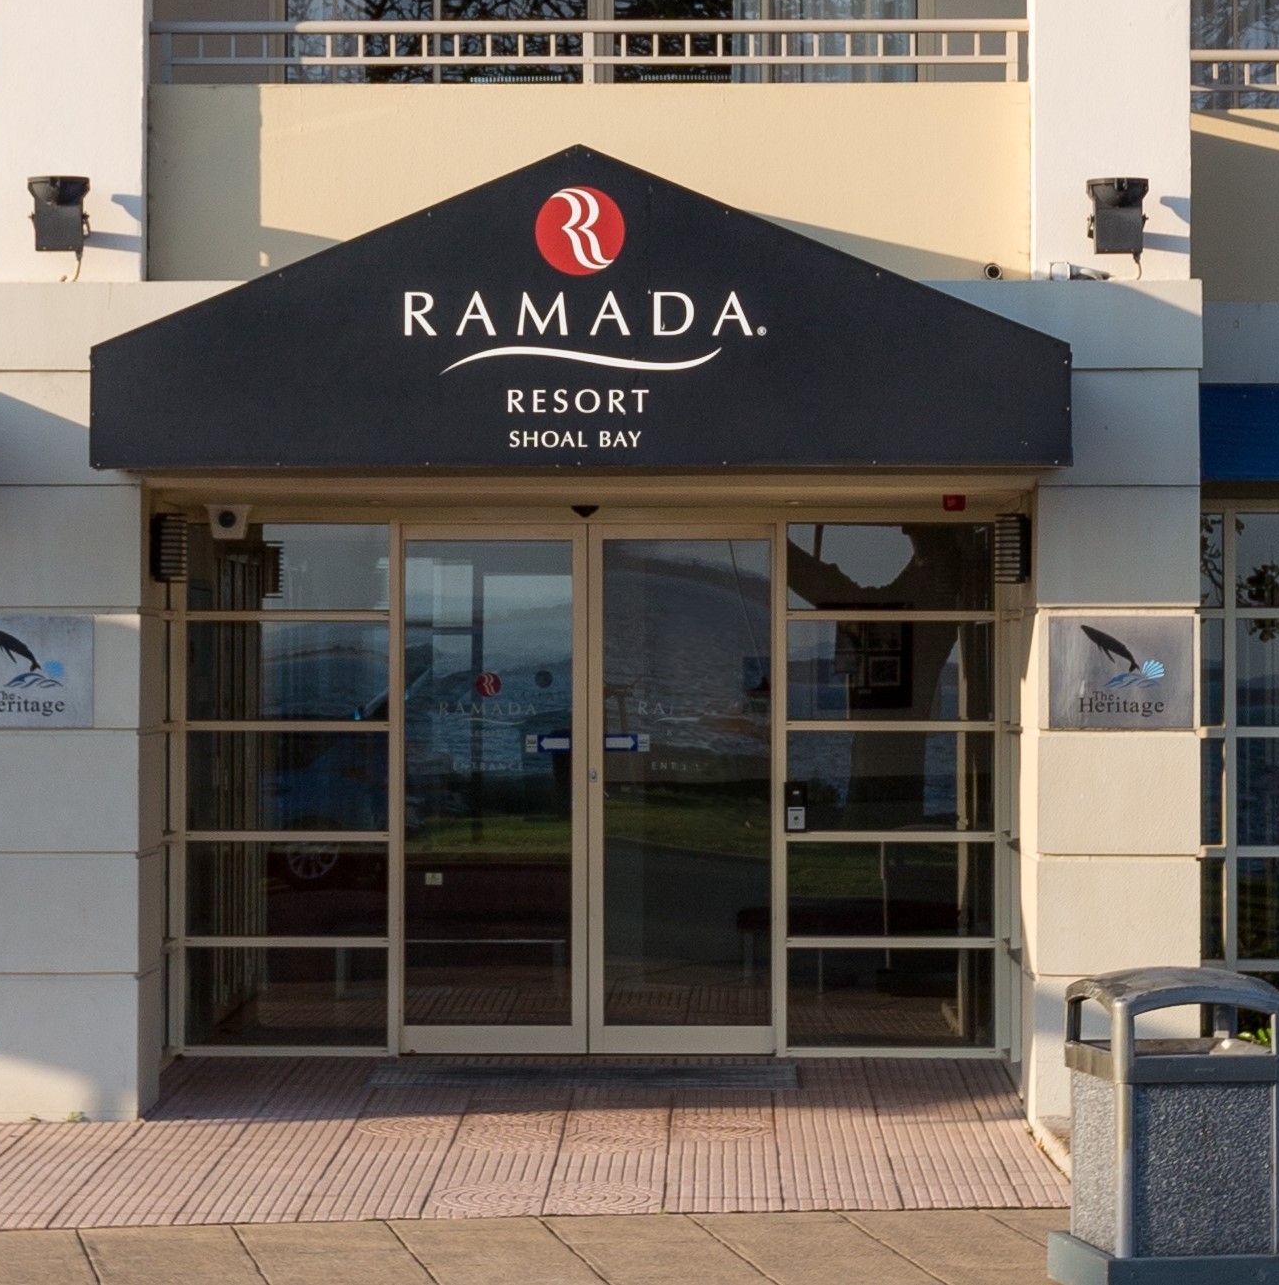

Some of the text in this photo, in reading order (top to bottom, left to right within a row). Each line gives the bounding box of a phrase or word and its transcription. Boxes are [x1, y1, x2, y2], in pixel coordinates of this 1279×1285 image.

[507, 389, 650, 416] RESORT
[509, 431, 642, 449] SHOAL BAY
[1093, 691, 1114, 701] The
[439, 702, 537, 716] RAMADA
[1079, 696, 1164, 717] Heritage
